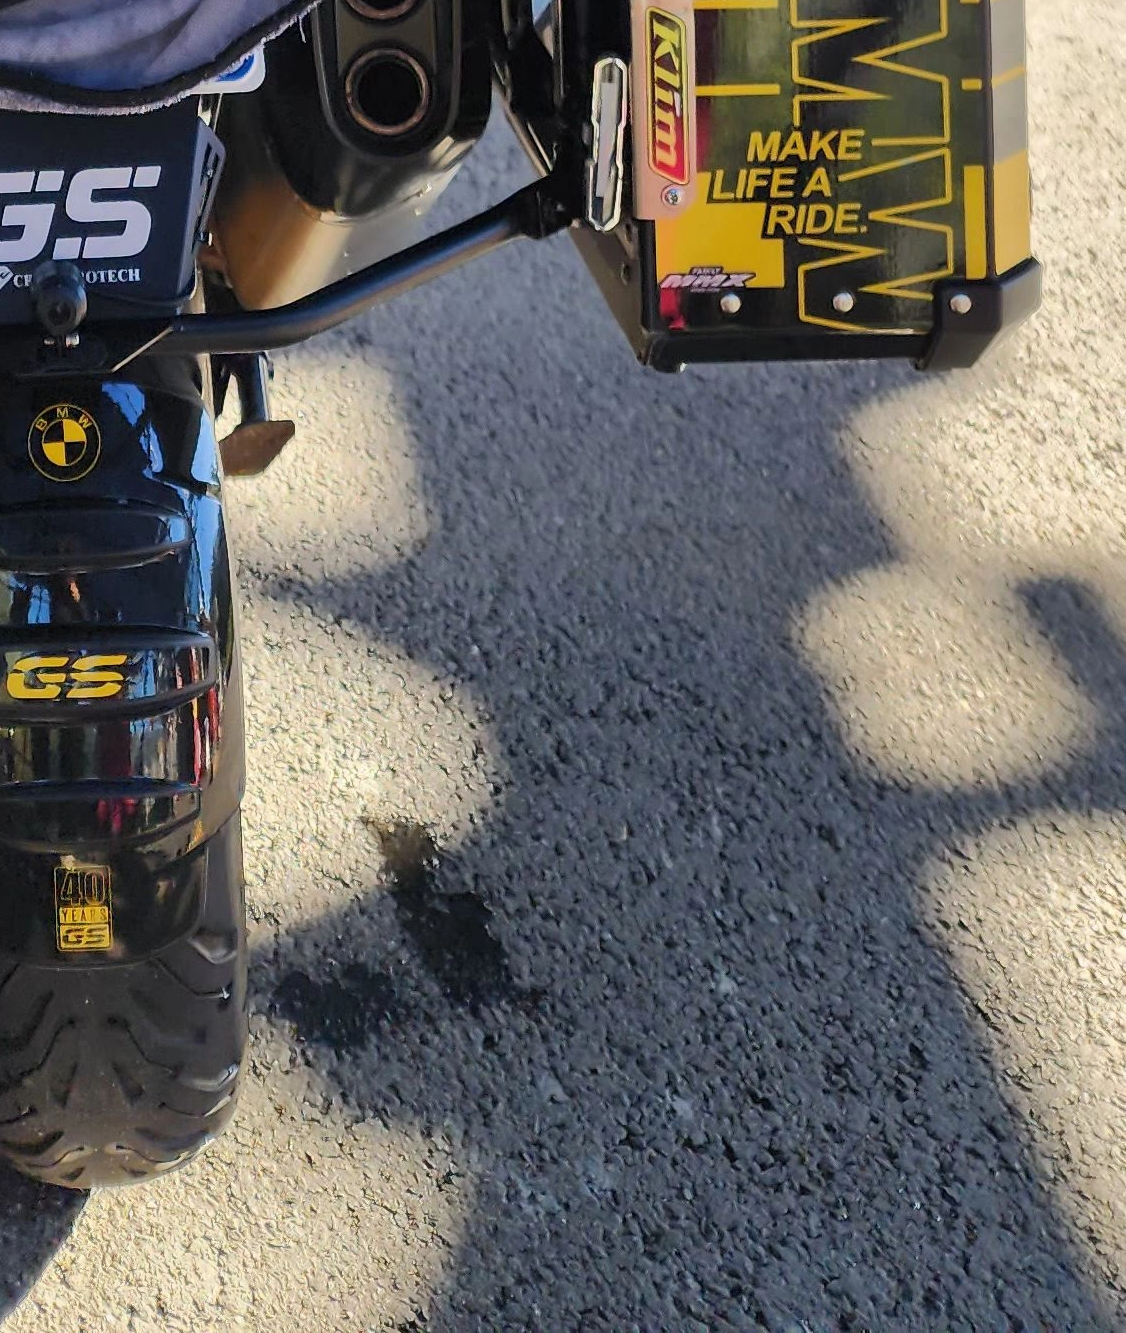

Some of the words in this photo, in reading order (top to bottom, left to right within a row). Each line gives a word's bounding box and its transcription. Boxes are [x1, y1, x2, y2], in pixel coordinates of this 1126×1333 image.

[653, 18, 682, 167] Klim
[746, 128, 865, 162] MAKE
[712, 166, 798, 200] LIFE
[801, 166, 832, 198] A
[765, 202, 868, 236] RIDE.
[35, 405, 92, 432] BMW
[5, 653, 128, 701] GS
[60, 870, 107, 908] 40
[61, 907, 109, 923] YEARS
[62, 926, 108, 946] GS
